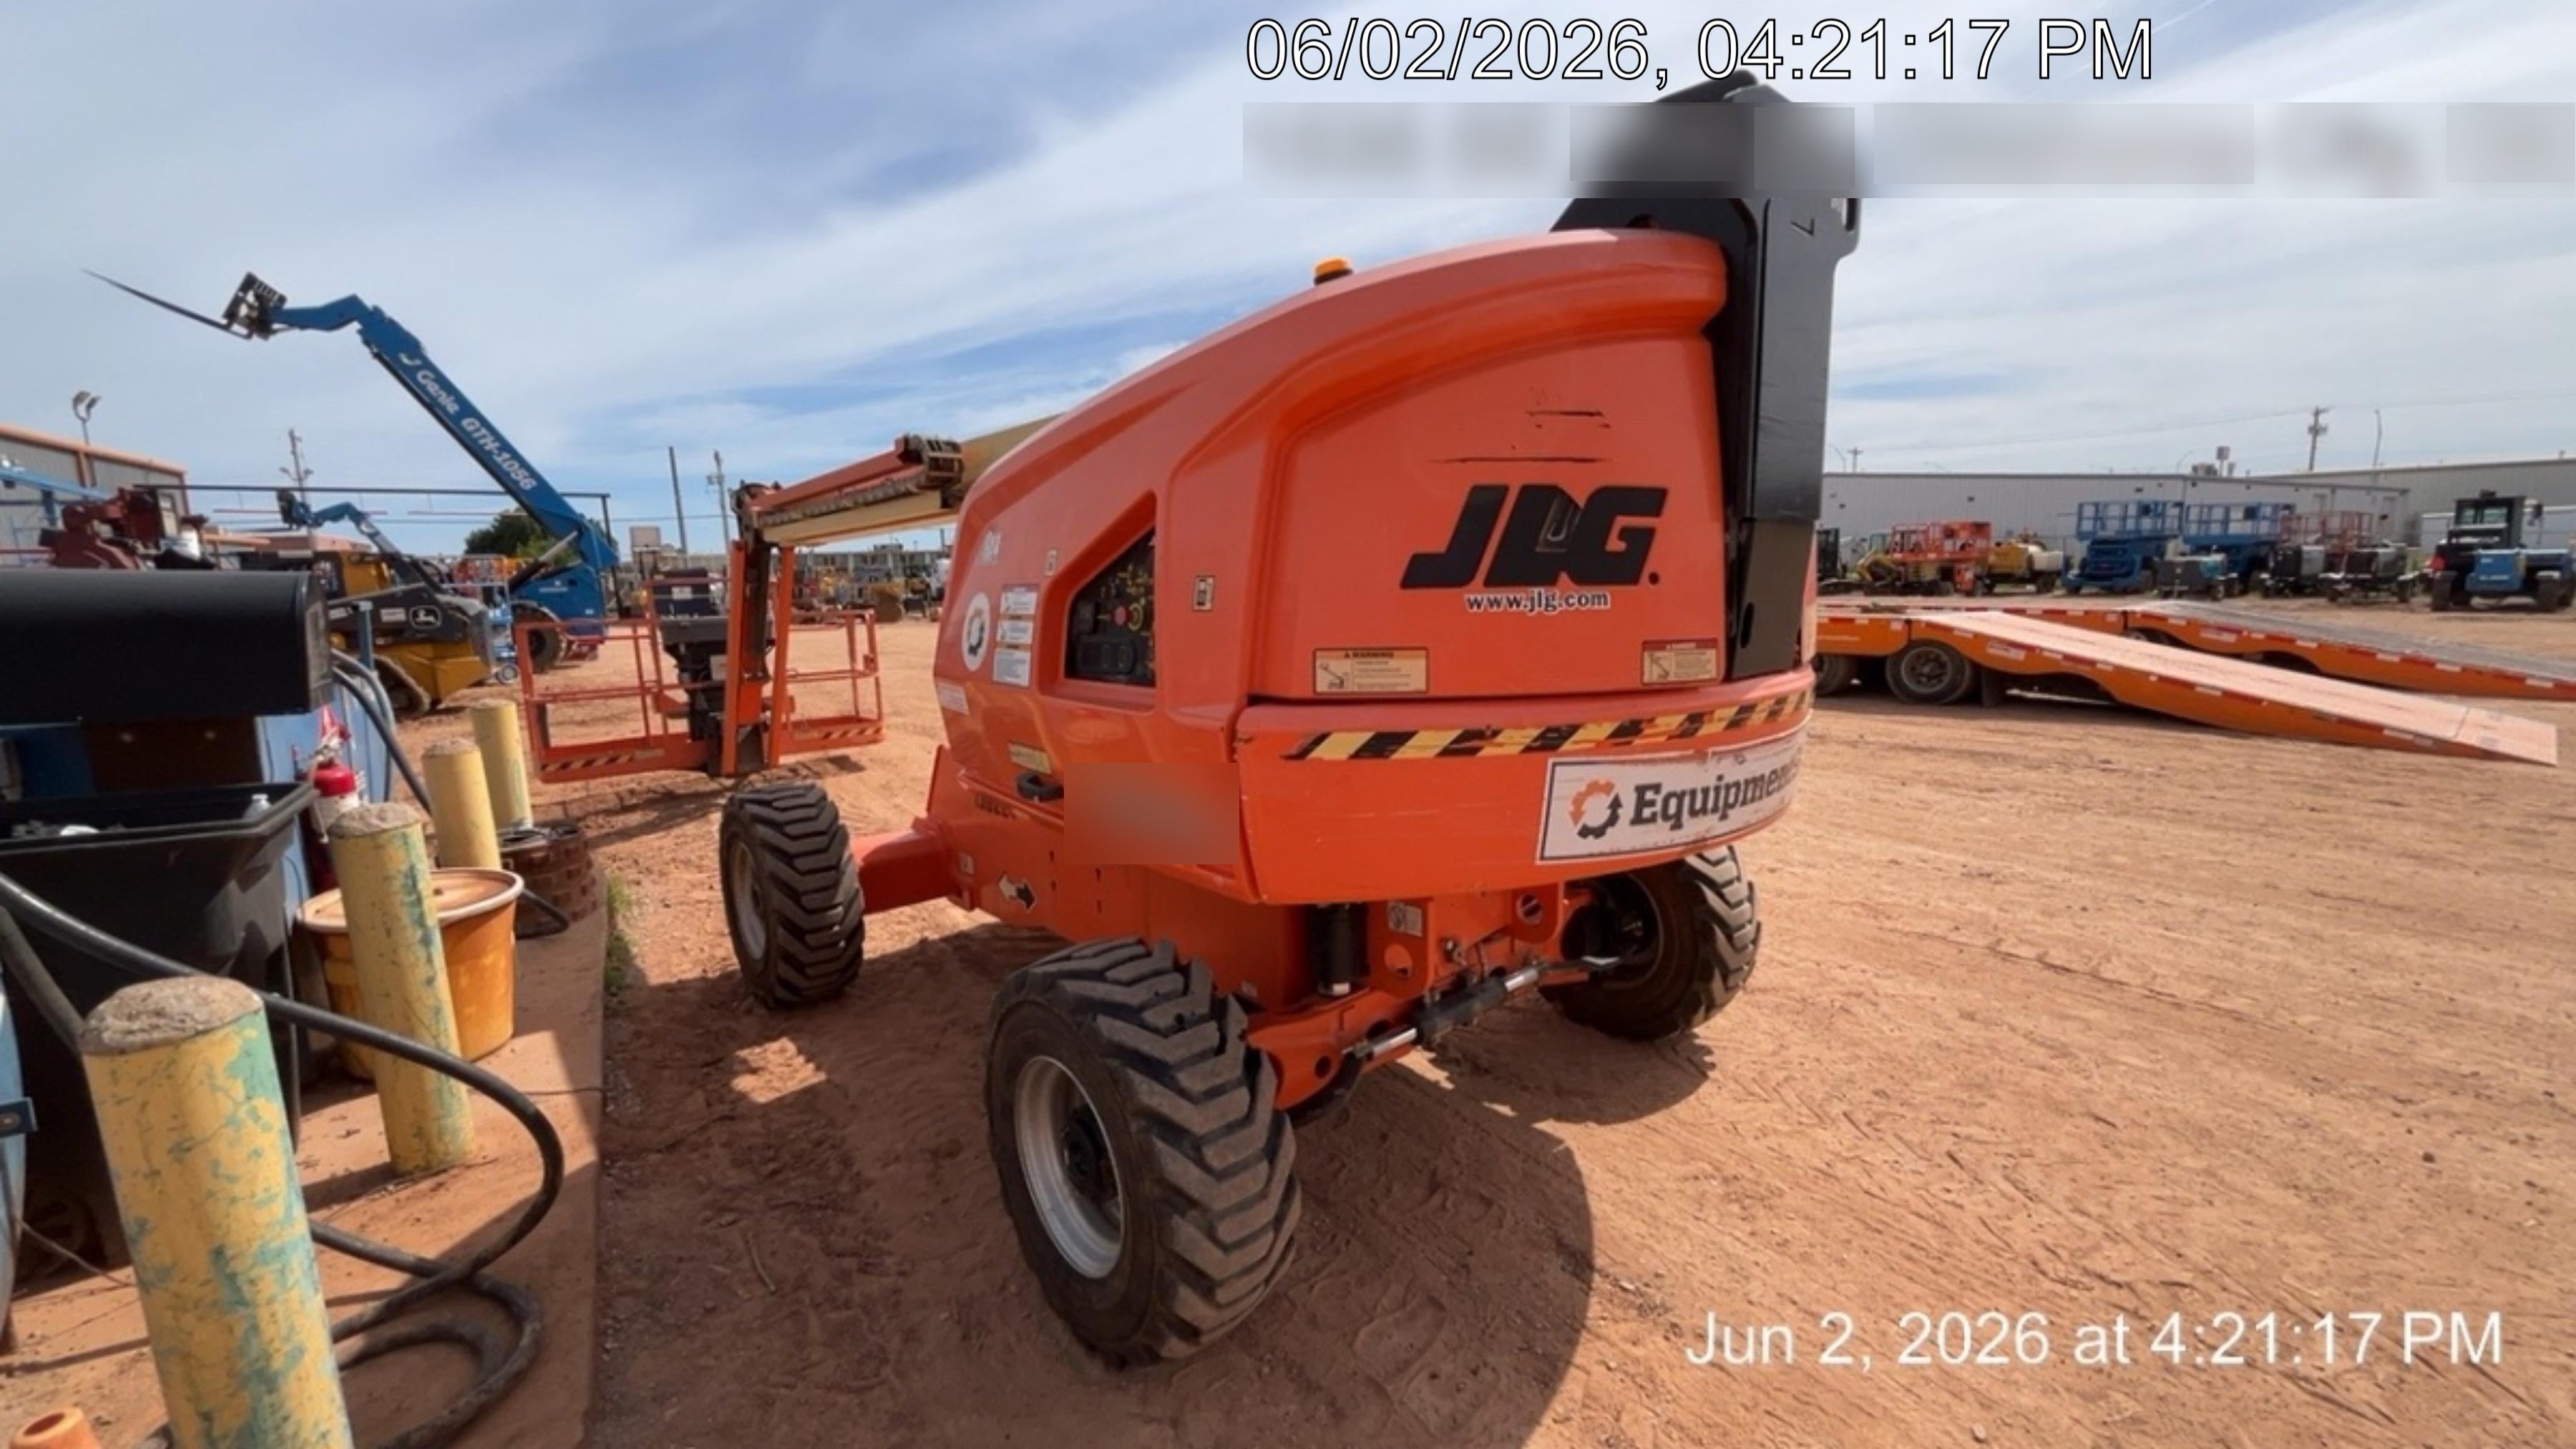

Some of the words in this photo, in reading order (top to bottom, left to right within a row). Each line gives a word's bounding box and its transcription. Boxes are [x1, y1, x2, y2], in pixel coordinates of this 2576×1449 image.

[416, 369, 459, 414] Genie
[461, 418, 536, 489] GTH-1056
[1467, 589, 1610, 614] www.jlg.com
[1629, 761, 1798, 831] Equipmen
